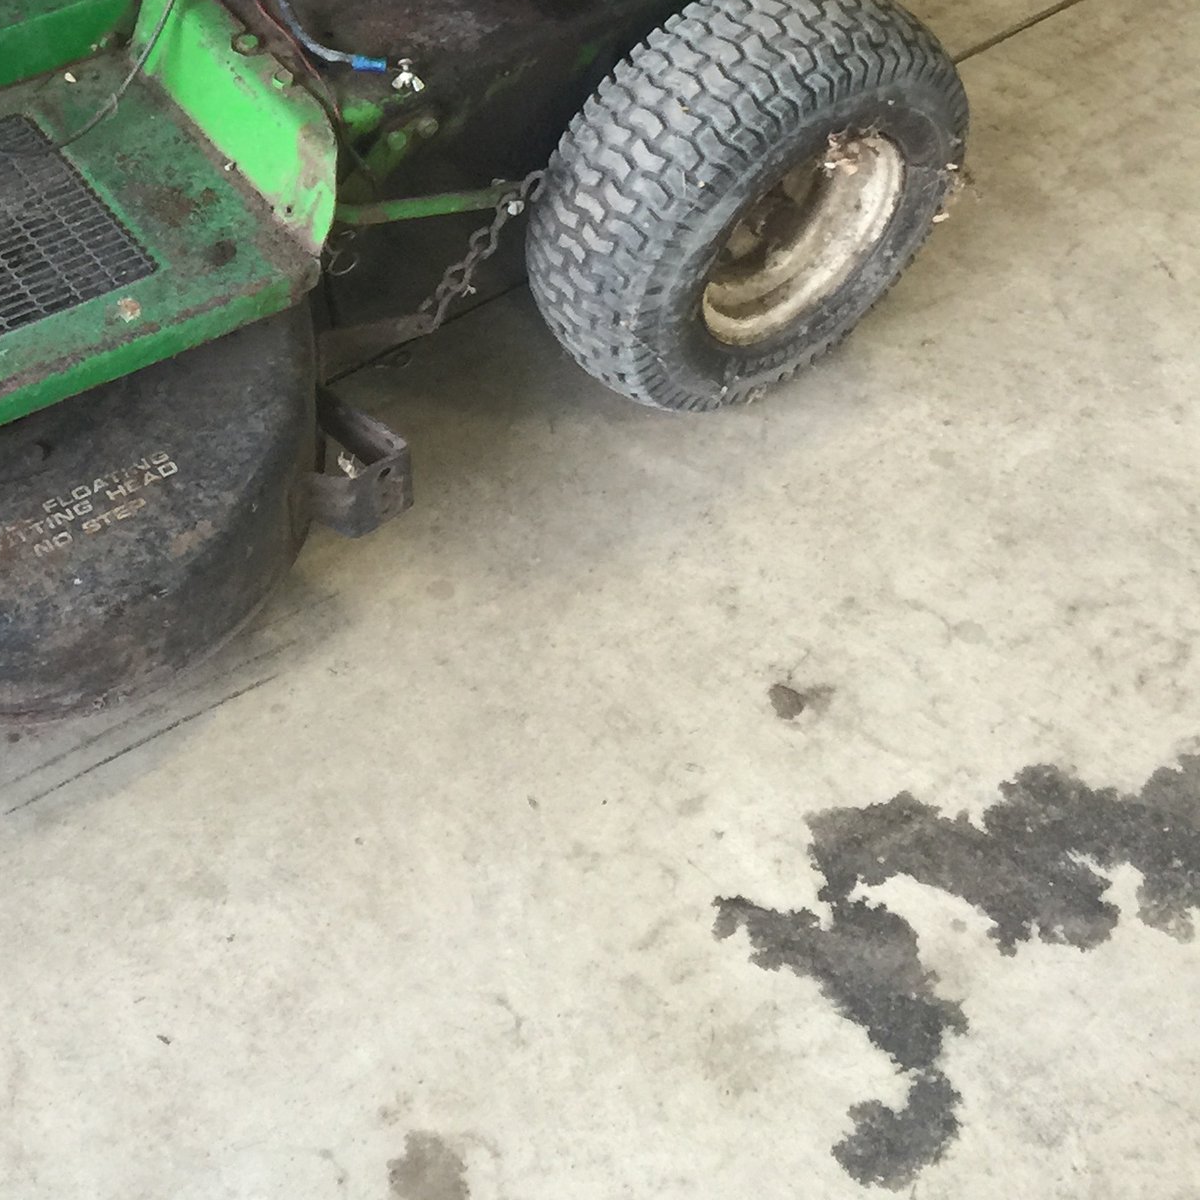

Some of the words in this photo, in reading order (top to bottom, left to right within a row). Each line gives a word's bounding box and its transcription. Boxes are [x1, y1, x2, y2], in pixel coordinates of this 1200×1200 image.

[42, 451, 169, 513] FLOATING
[106, 461, 179, 502] HEAD
[33, 531, 74, 558] NO
[82, 497, 146, 534] STEP
